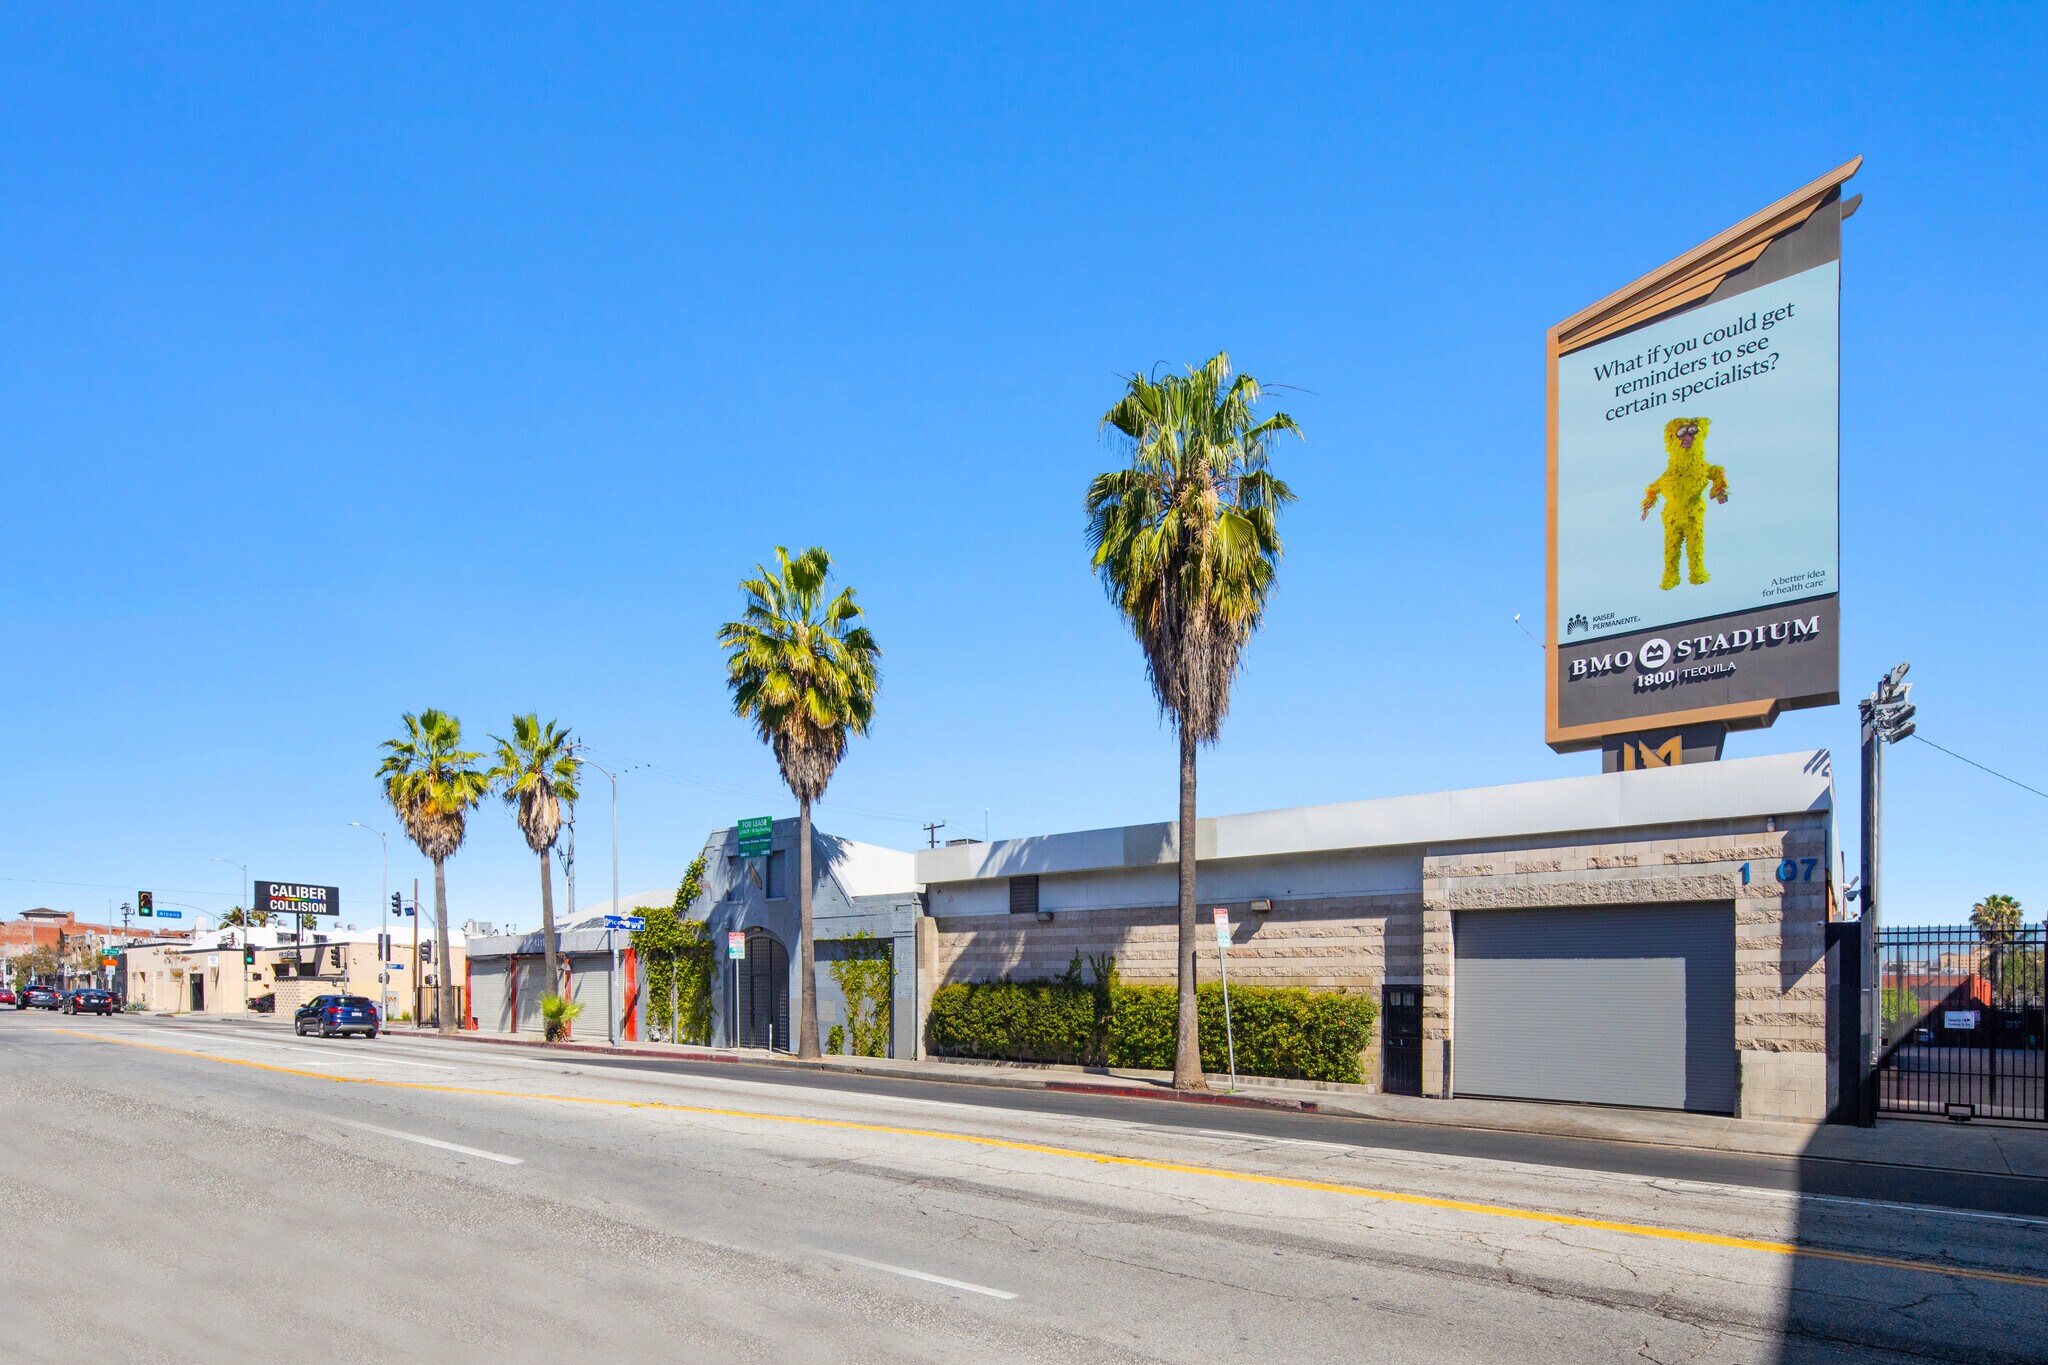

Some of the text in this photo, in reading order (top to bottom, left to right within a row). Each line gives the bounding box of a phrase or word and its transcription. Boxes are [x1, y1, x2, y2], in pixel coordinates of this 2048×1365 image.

[1593, 303, 1795, 381] What if you could get
[1615, 337, 1769, 397] reminders to see
[1605, 352, 1780, 421] certain specialists?
[1771, 570, 1826, 587] A better idea
[1762, 580, 1824, 597] for health care
[1592, 612, 1615, 623] KAISER
[1572, 615, 1820, 676] BMO STADIUM
[1637, 661, 1737, 687] 1800 TEQUILA
[742, 818, 767, 829] FOR LEASE
[269, 884, 327, 900] CALIBER
[269, 899, 327, 913] COLLISION
